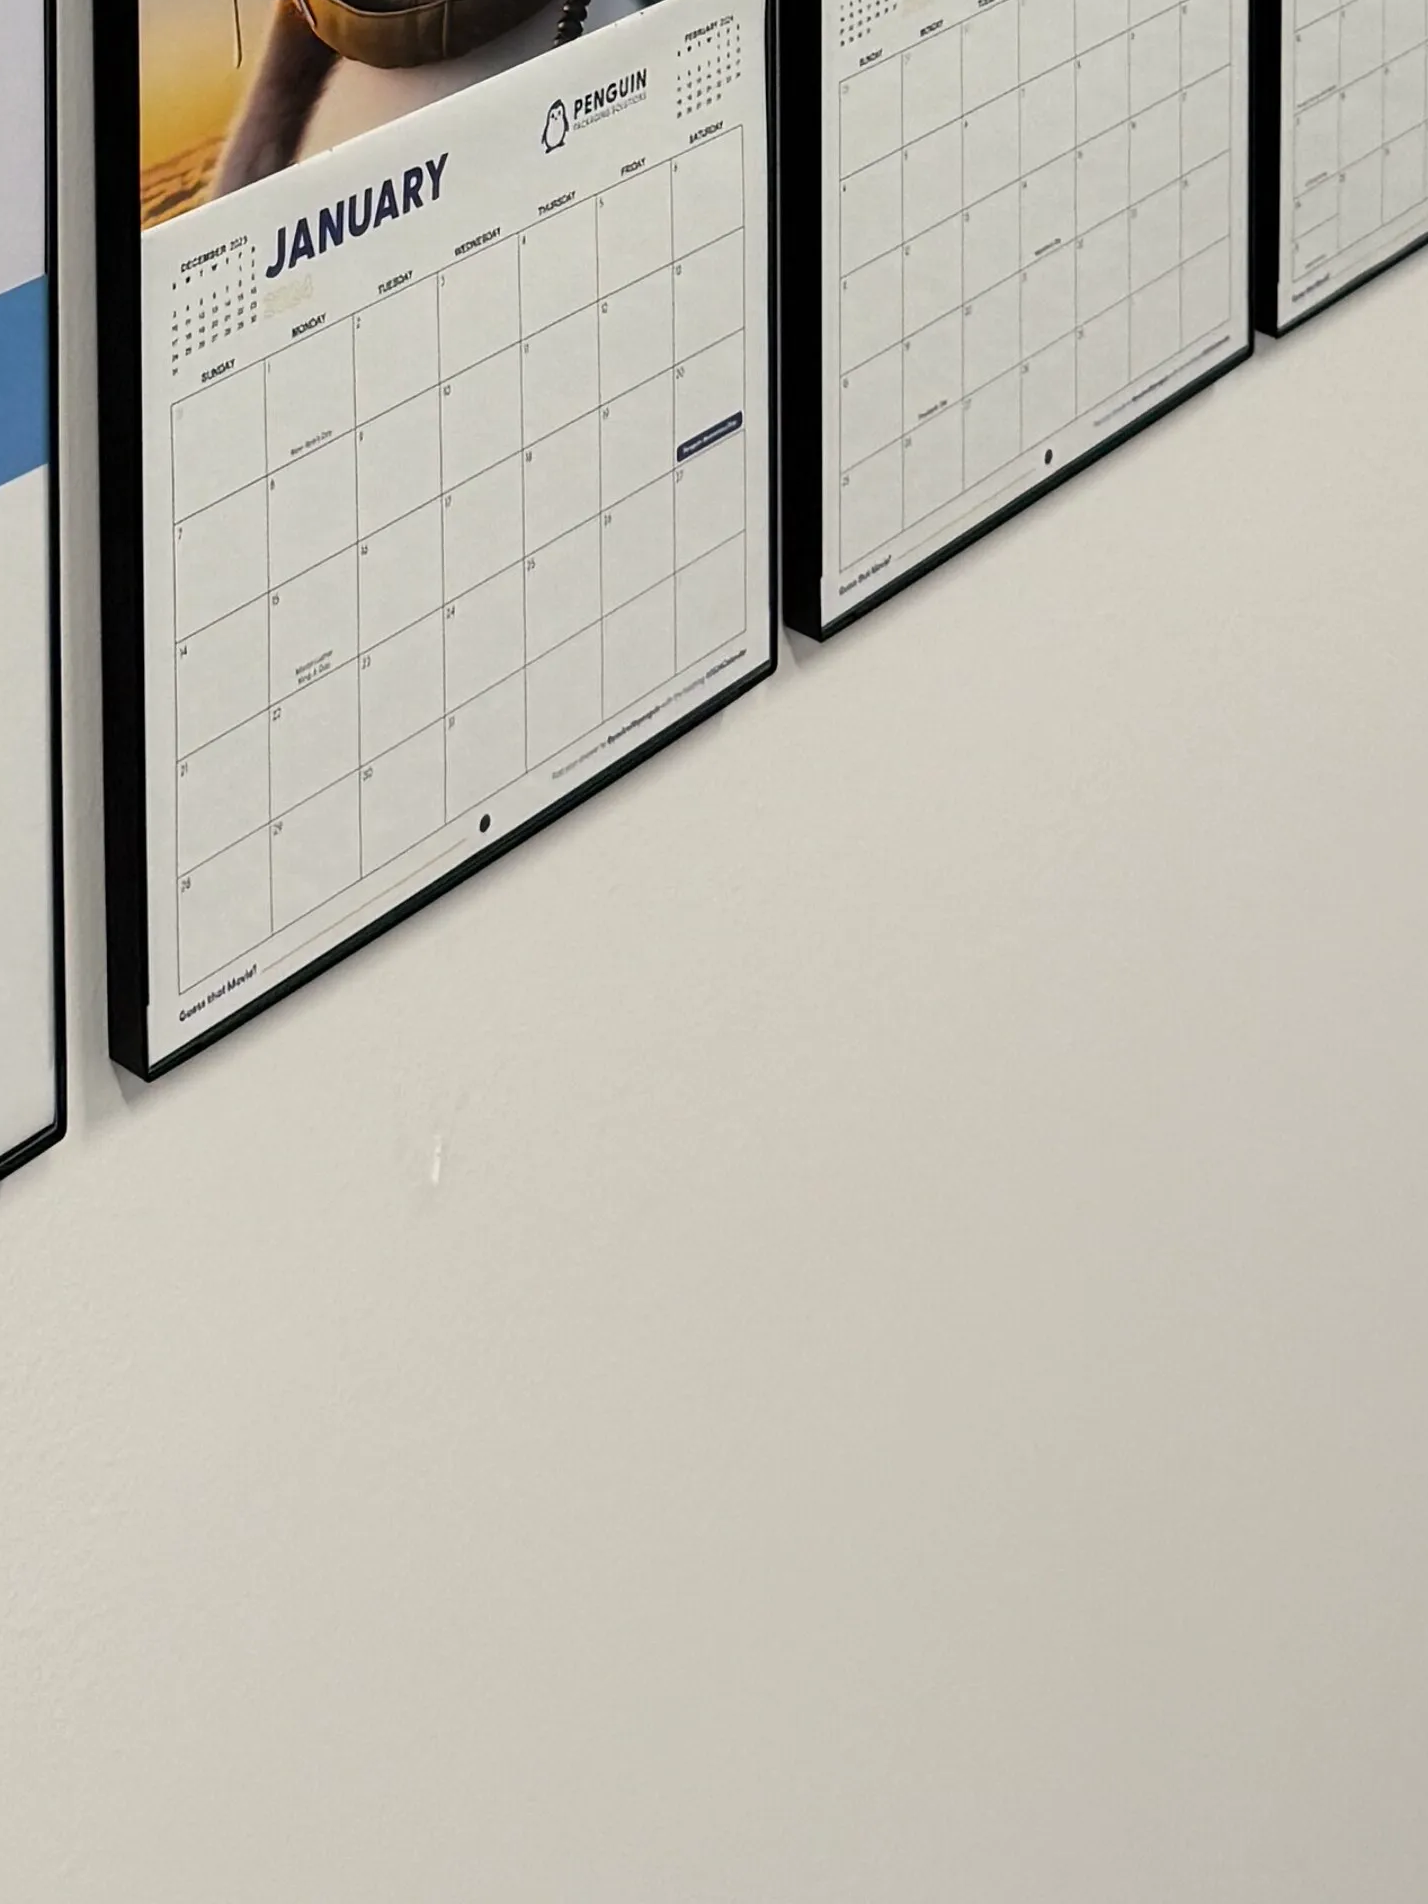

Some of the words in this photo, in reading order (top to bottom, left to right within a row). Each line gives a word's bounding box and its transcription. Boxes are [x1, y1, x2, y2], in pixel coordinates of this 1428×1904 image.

[573, 68, 648, 120] PENGUIN
[265, 152, 449, 279] JANUARY
[180, 243, 227, 273] DECEMBER
[201, 358, 236, 383] SUNDAY
[291, 312, 327, 338] MONDAY
[378, 270, 414, 295] TUESDAY
